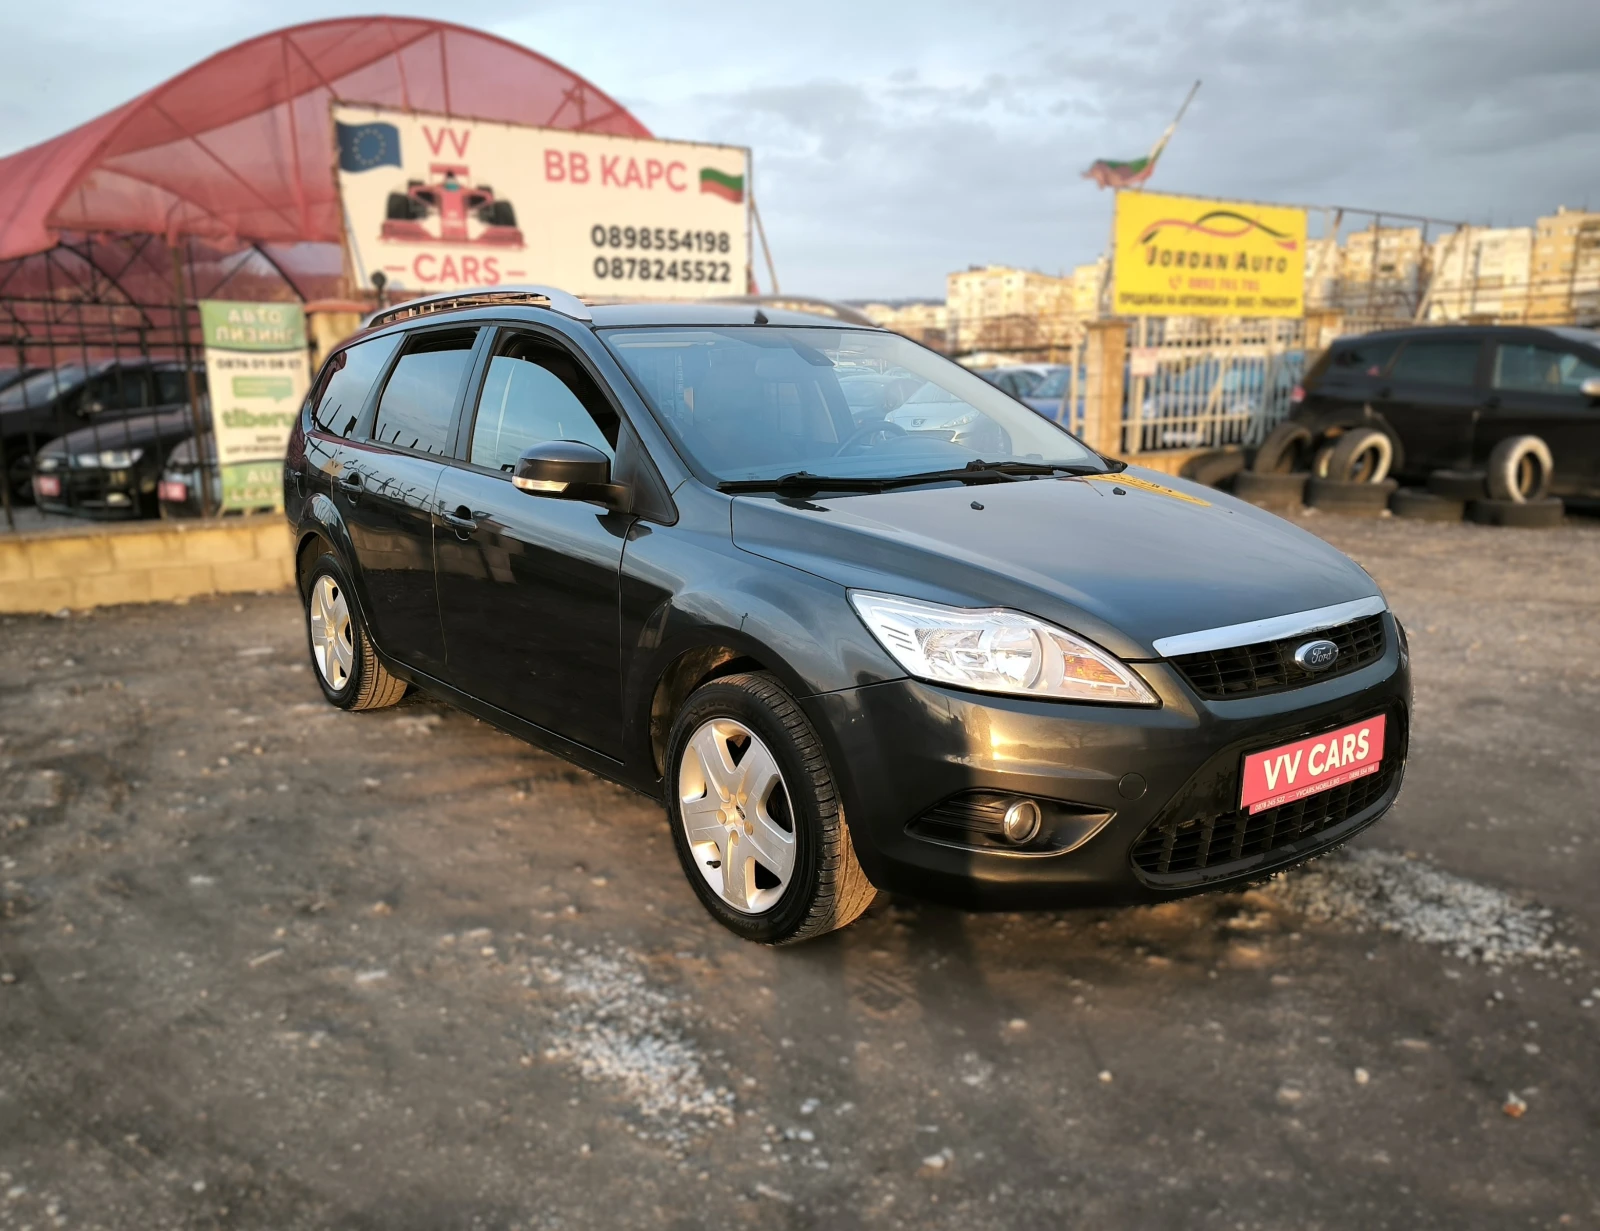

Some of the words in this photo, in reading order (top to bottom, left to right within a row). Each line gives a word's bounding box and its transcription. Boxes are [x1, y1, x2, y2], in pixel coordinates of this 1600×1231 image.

[422, 125, 471, 158] VV
[600, 154, 688, 192] КАРС
[591, 224, 732, 253] 0898554198
[412, 254, 501, 285] CARS
[593, 256, 732, 283] 0878245522
[228, 308, 282, 325] АВТО
[1311, 646, 1332, 664] Ford
[1263, 749, 1304, 791] VV
[1307, 728, 1370, 777] CARS
